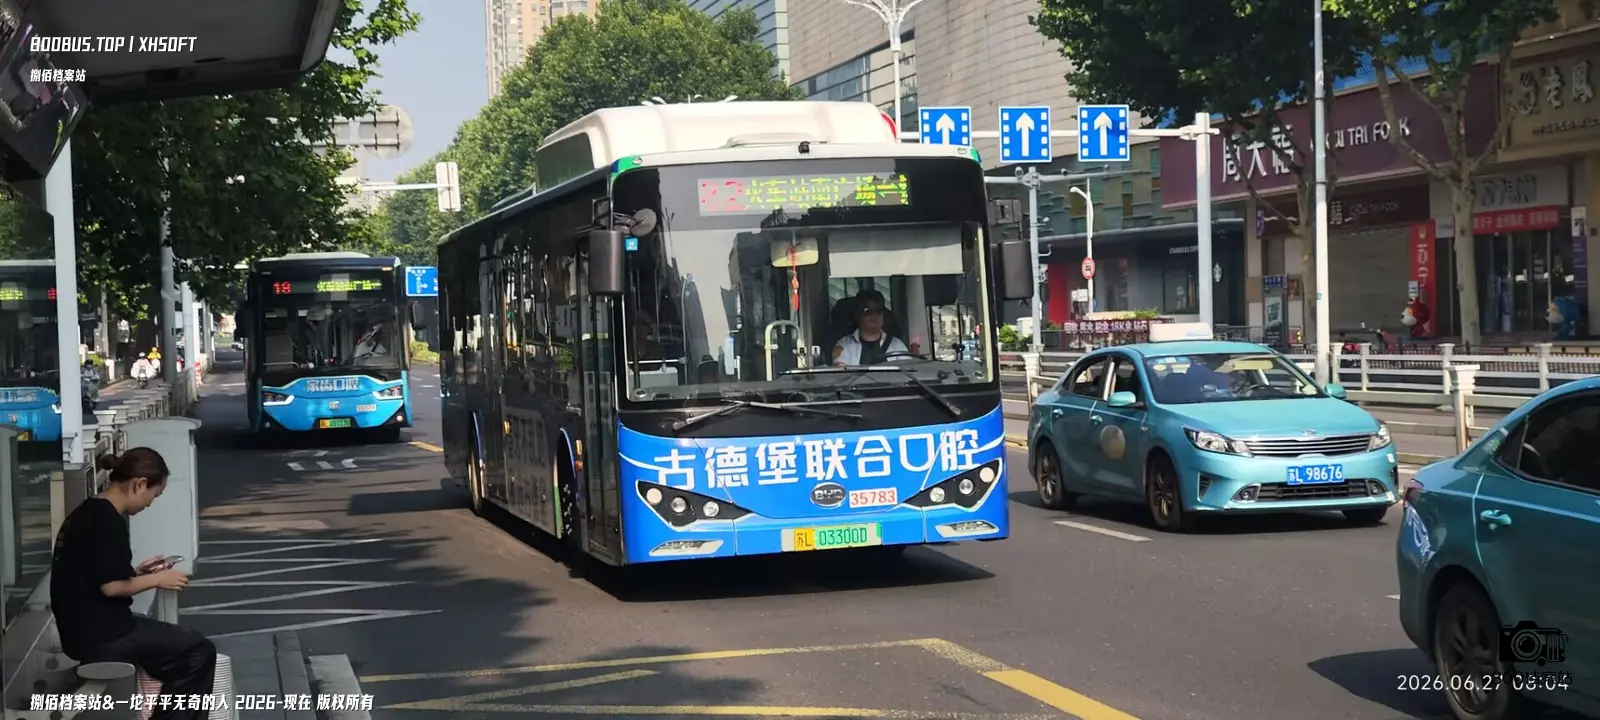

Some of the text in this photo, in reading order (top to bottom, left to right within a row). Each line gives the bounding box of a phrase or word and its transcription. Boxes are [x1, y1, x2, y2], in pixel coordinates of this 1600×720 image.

[1347, 125, 1368, 146] TAI
[1373, 116, 1410, 142] FOK
[653, 431, 979, 491] 古德堡联合口腔
[1305, 466, 1342, 480] 98676
[814, 489, 843, 500] BYD
[850, 490, 896, 506] 35783
[819, 528, 868, 546] 03300D
